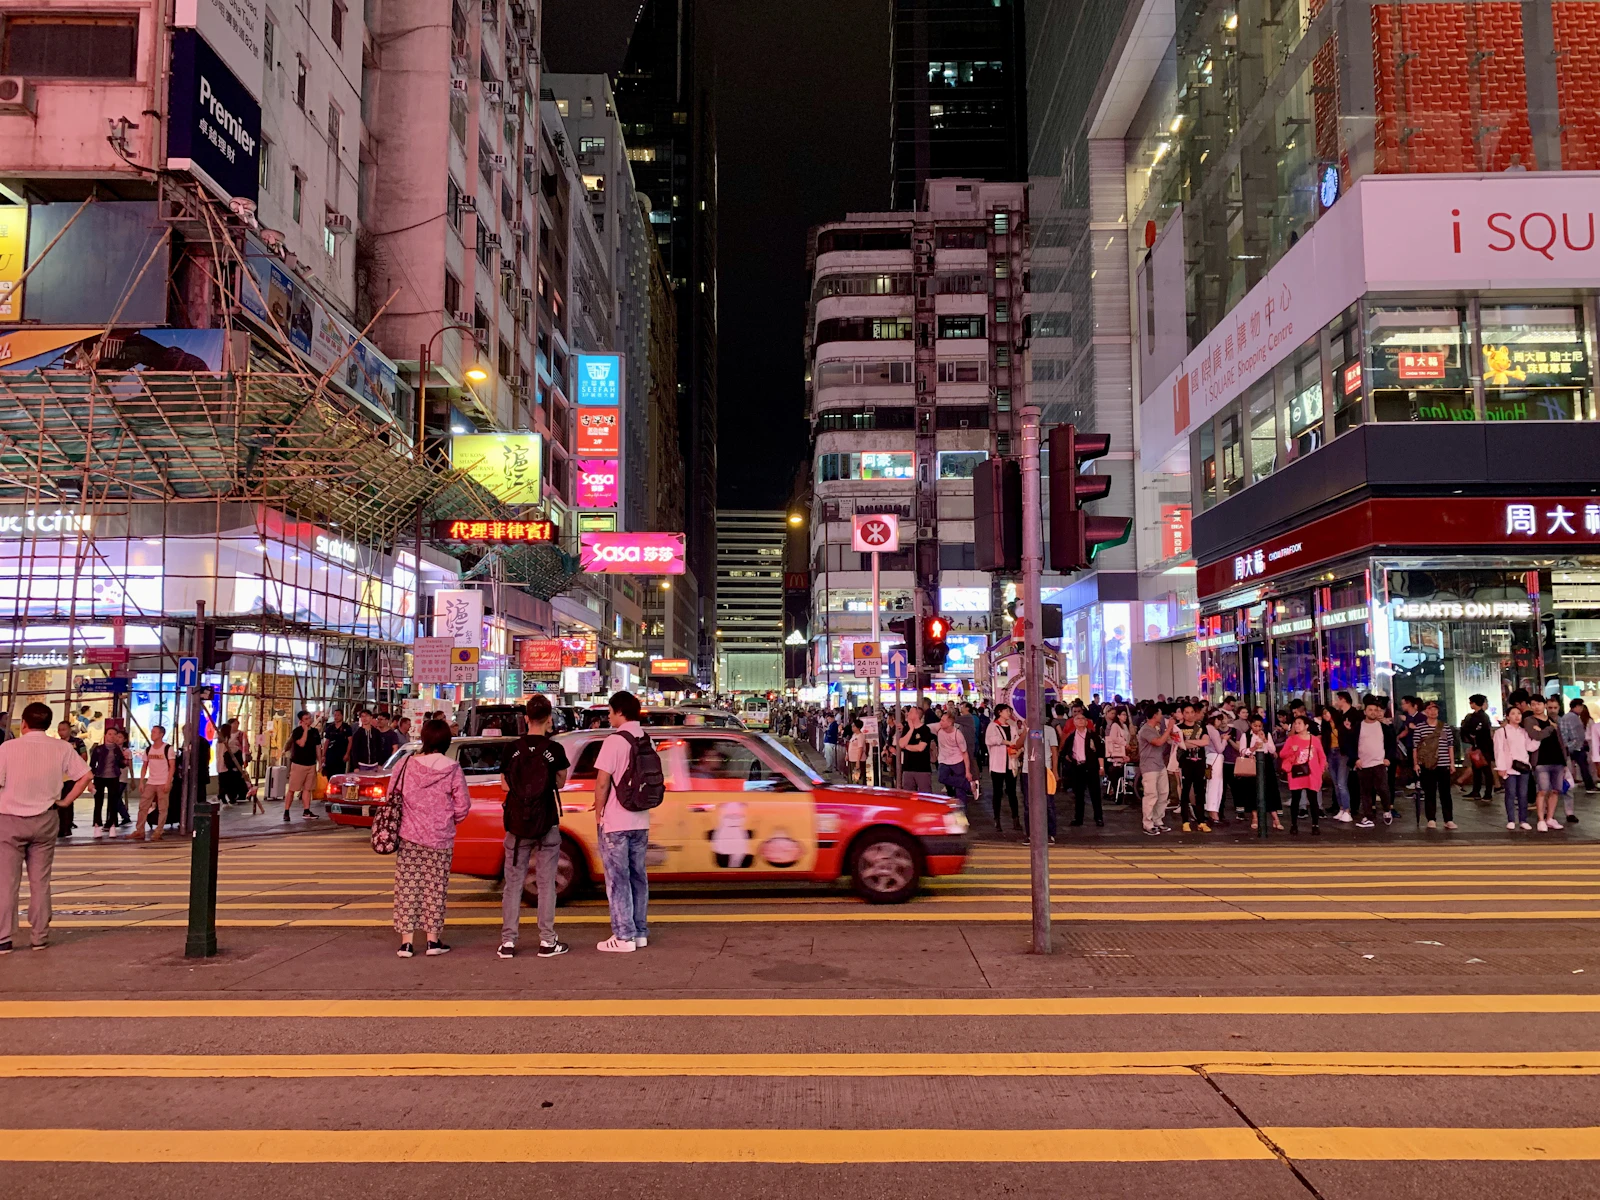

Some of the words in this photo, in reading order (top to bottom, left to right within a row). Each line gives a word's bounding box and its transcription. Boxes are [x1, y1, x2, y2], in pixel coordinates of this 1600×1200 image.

[200, 75, 256, 157] Premier
[199, 118, 236, 164] 卓越理財
[1451, 208, 1462, 254] i
[1487, 212, 1596, 261] SQU
[1190, 282, 1292, 396] 國際廣場購物中心
[1209, 366, 1236, 402] SQUARE
[1238, 344, 1267, 378] Shopping
[1267, 322, 1293, 351] Centre
[1405, 356, 1439, 367] 周大福
[580, 414, 617, 427] 古早味
[581, 472, 615, 485] Sasa
[592, 543, 640, 562] Sasa
[643, 546, 674, 562] 莎莎
[1234, 549, 1265, 580] 周大福
[1322, 611, 1347, 626] FRANCK
[1395, 602, 1463, 619] HEARTS
[1465, 602, 1491, 618] ON
[1492, 602, 1533, 618] FIRE
[1272, 623, 1292, 635] FRANCK
[456, 673, 473, 681] 全日
[860, 667, 877, 676] 全日
